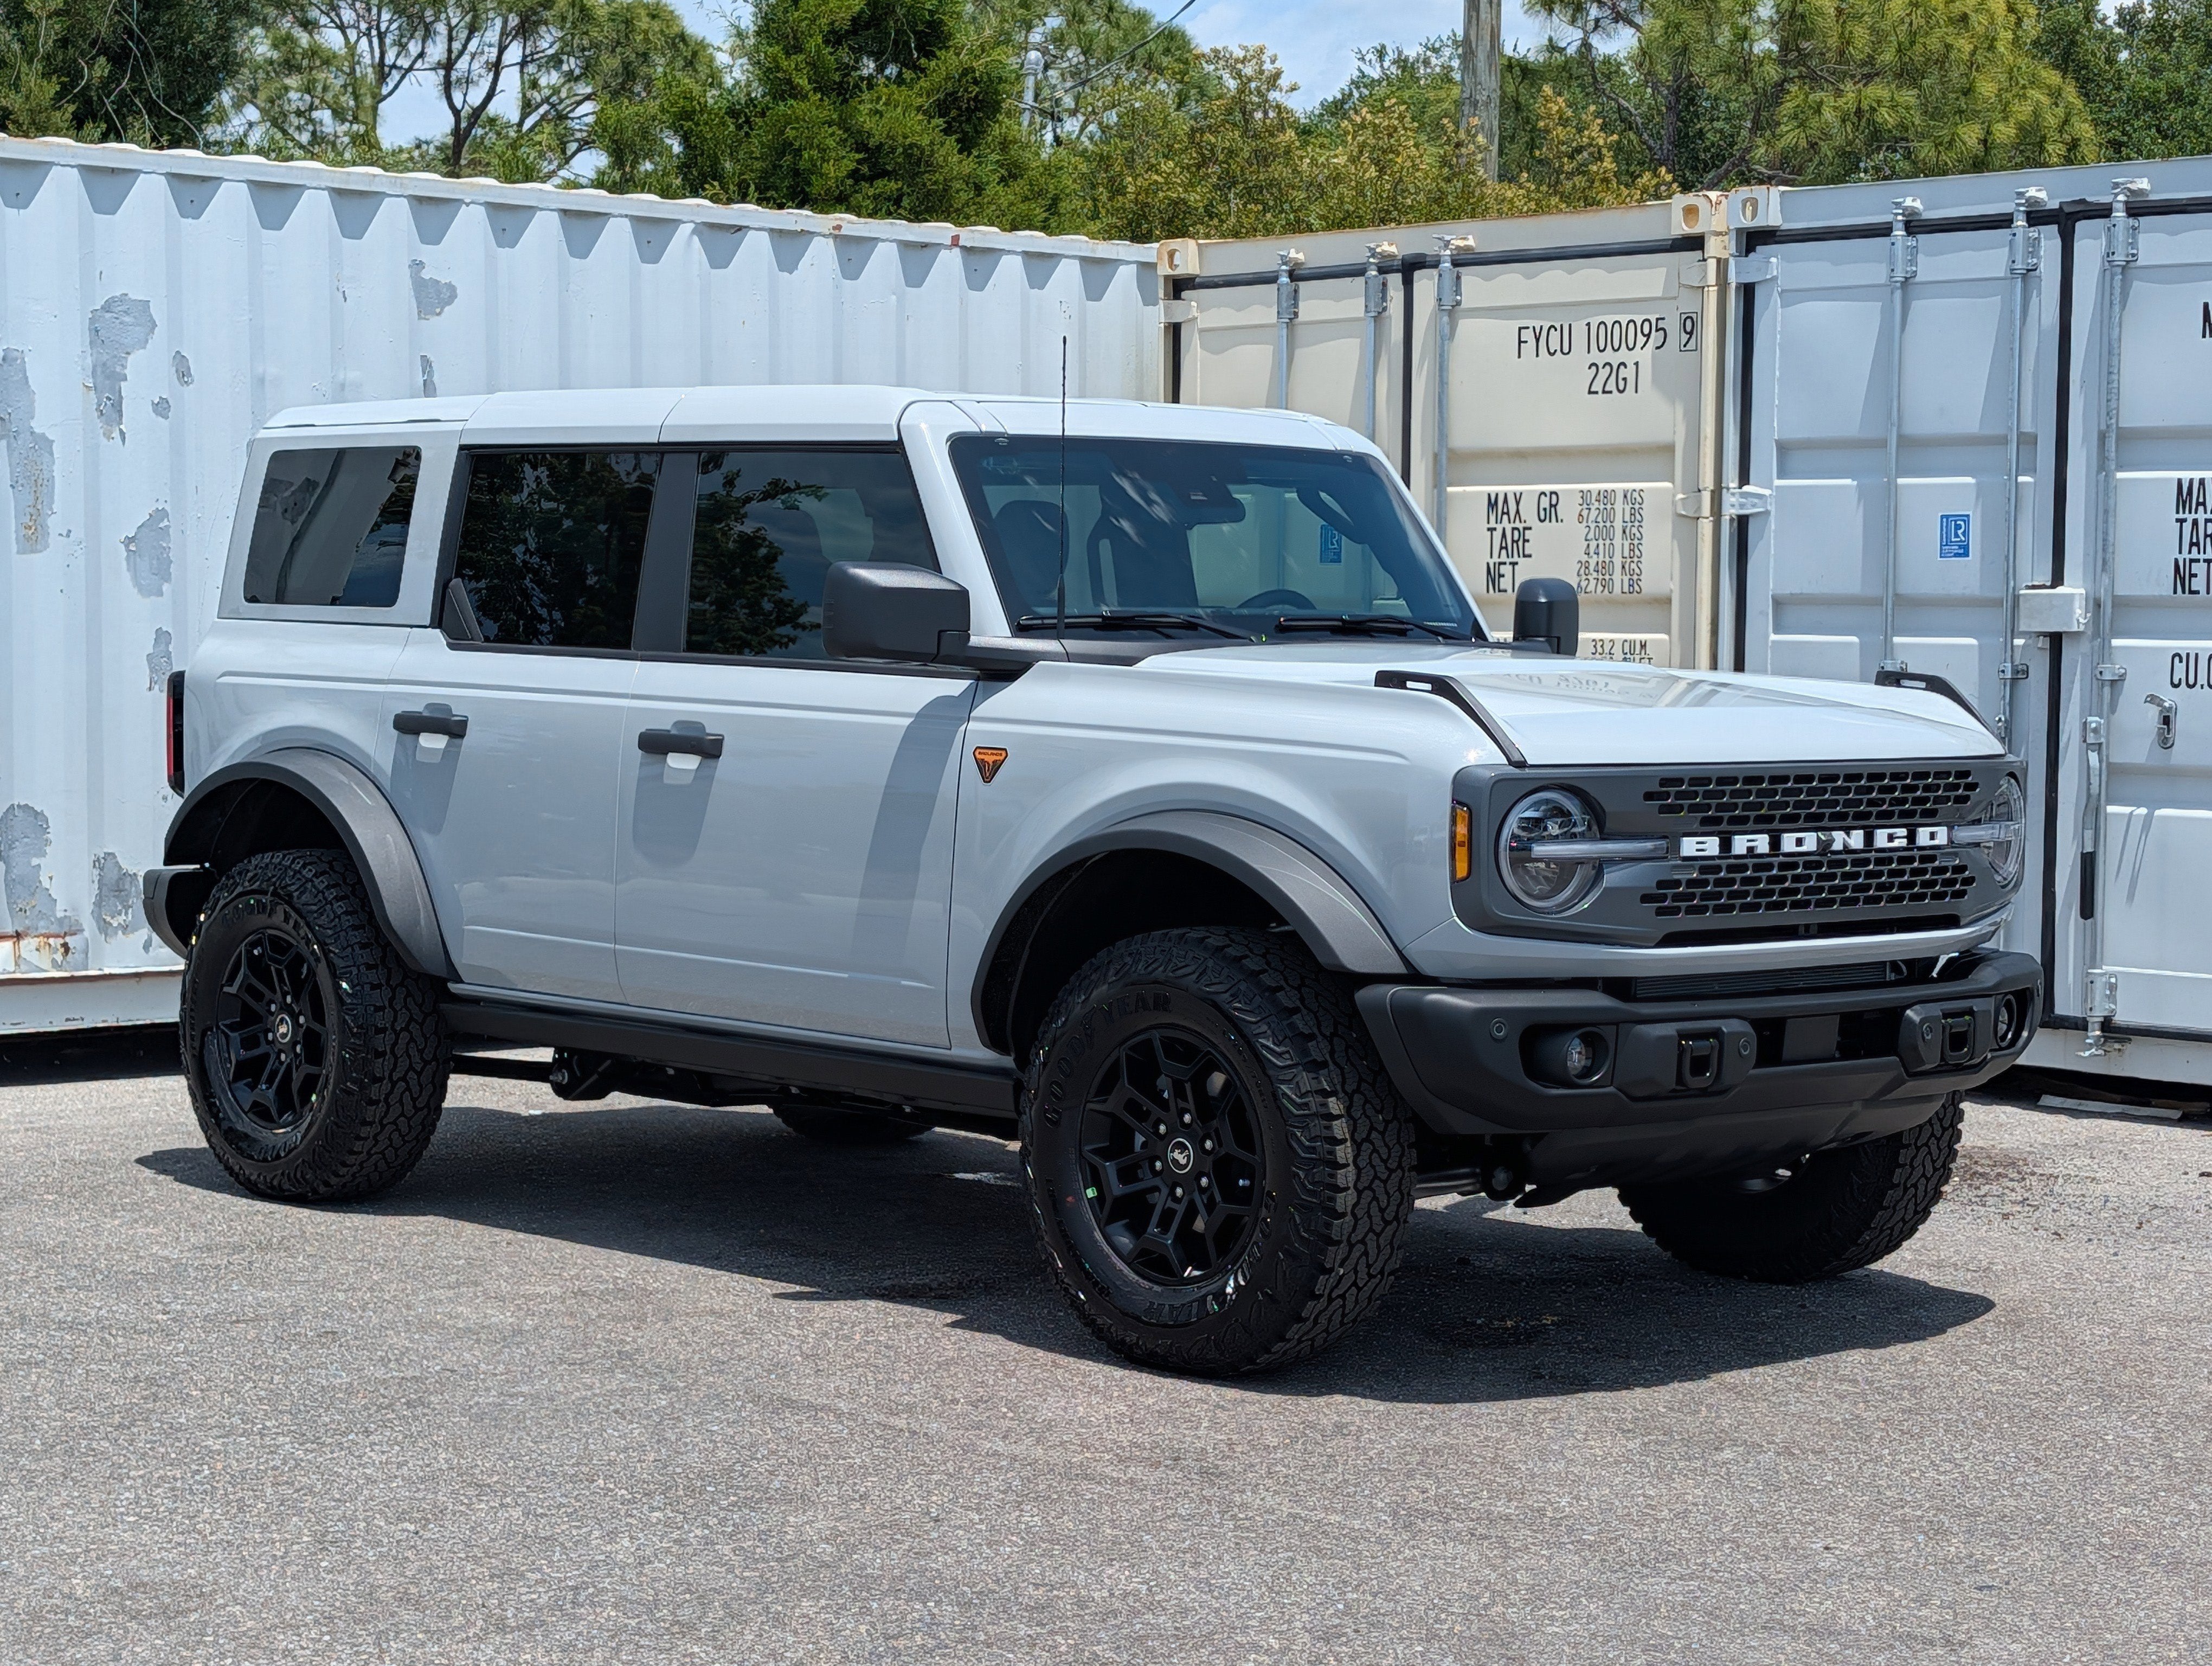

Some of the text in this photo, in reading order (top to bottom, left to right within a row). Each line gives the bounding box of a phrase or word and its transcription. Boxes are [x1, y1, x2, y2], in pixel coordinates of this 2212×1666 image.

[1517, 315, 1695, 359] FYCU 100095 9
[1587, 361, 1639, 395] 22G1
[1487, 491, 1563, 524] MAX. GR.
[1578, 489, 1644, 506] 30.480 KGS
[2175, 478, 2212, 515] MA
[1622, 507, 1644, 523] LBS
[1487, 527, 1532, 559] TARE
[1584, 524, 1643, 541] 2.000 KGS
[1952, 521, 1965, 541] LR
[1621, 542, 1643, 559] LBS
[1486, 561, 1519, 594] NET
[1577, 560, 1642, 576] 28.480 KGS
[2173, 558, 2212, 595] NET
[1621, 578, 1642, 594] LBS
[1591, 638, 1615, 656] 33.2
[1681, 826, 1949, 857] BRONCO
